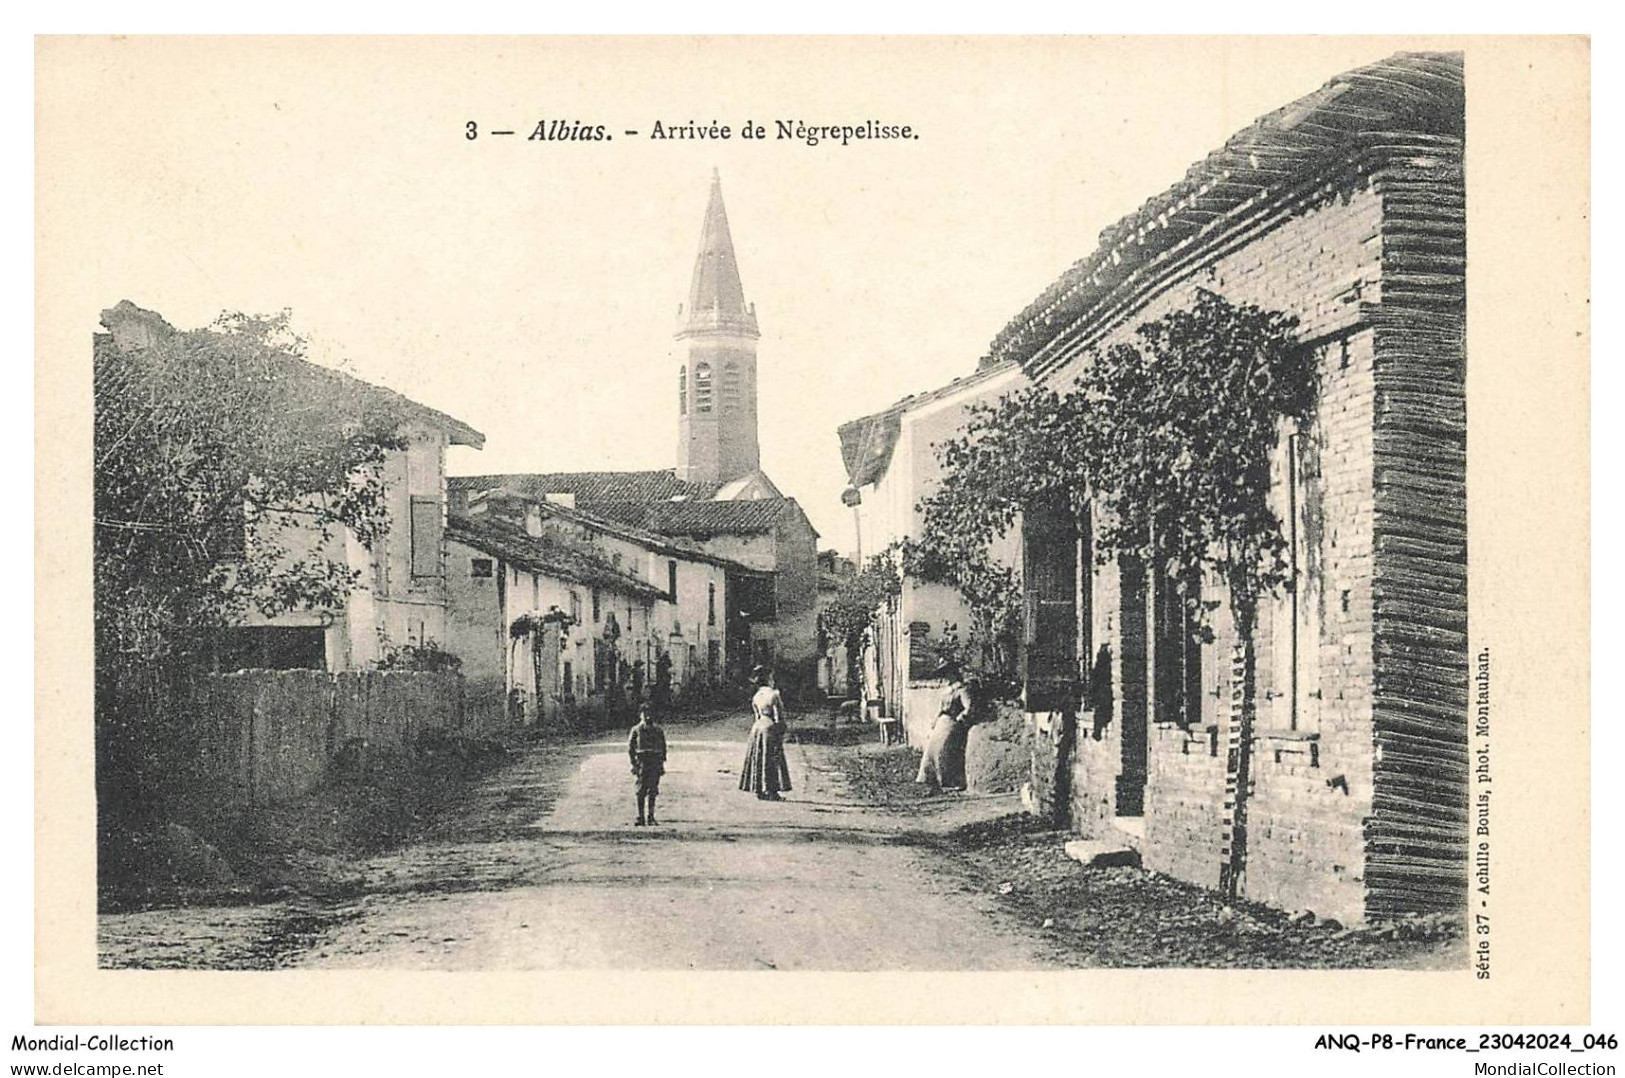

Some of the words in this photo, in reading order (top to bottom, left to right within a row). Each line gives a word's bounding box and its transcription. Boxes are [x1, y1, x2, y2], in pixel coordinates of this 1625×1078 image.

[466, 120, 478, 141] 3
[528, 119, 612, 141] Albias.
[650, 119, 731, 140] Arrivée
[741, 119, 766, 140] de
[775, 119, 919, 147] Nègrepelisse.
[1475, 647, 1490, 737] Montauban.
[1475, 743, 1492, 784] phot.
[1475, 842, 1490, 895] Achille
[1475, 914, 1490, 935] 37
[1475, 941, 1490, 980] Série
